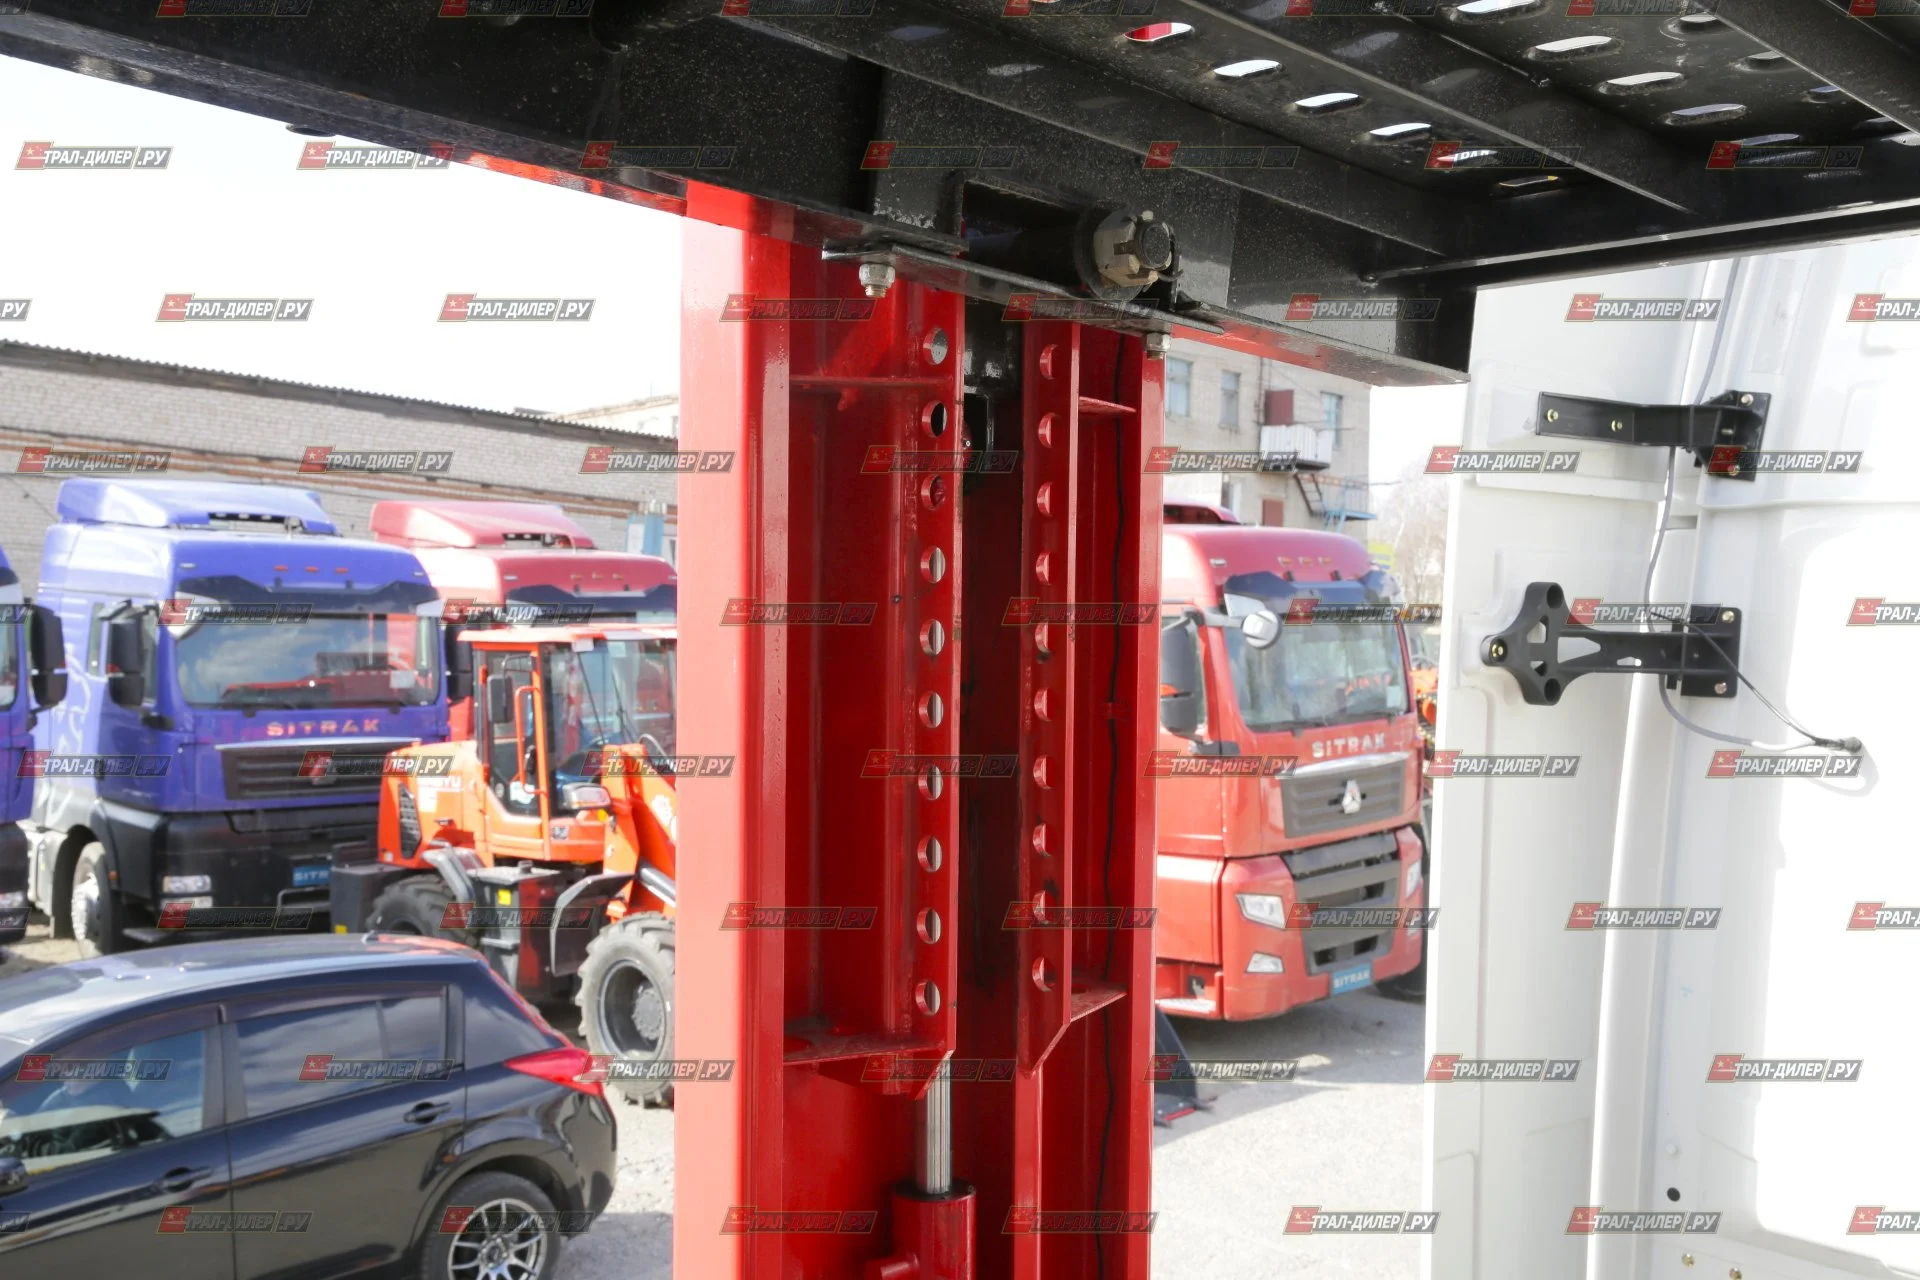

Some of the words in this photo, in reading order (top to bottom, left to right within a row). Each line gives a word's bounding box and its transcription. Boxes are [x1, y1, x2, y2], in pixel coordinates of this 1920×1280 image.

[266, 718, 379, 737] SITRAK
[1311, 732, 1385, 758] SITRAK
[293, 870, 329, 881] SITR
